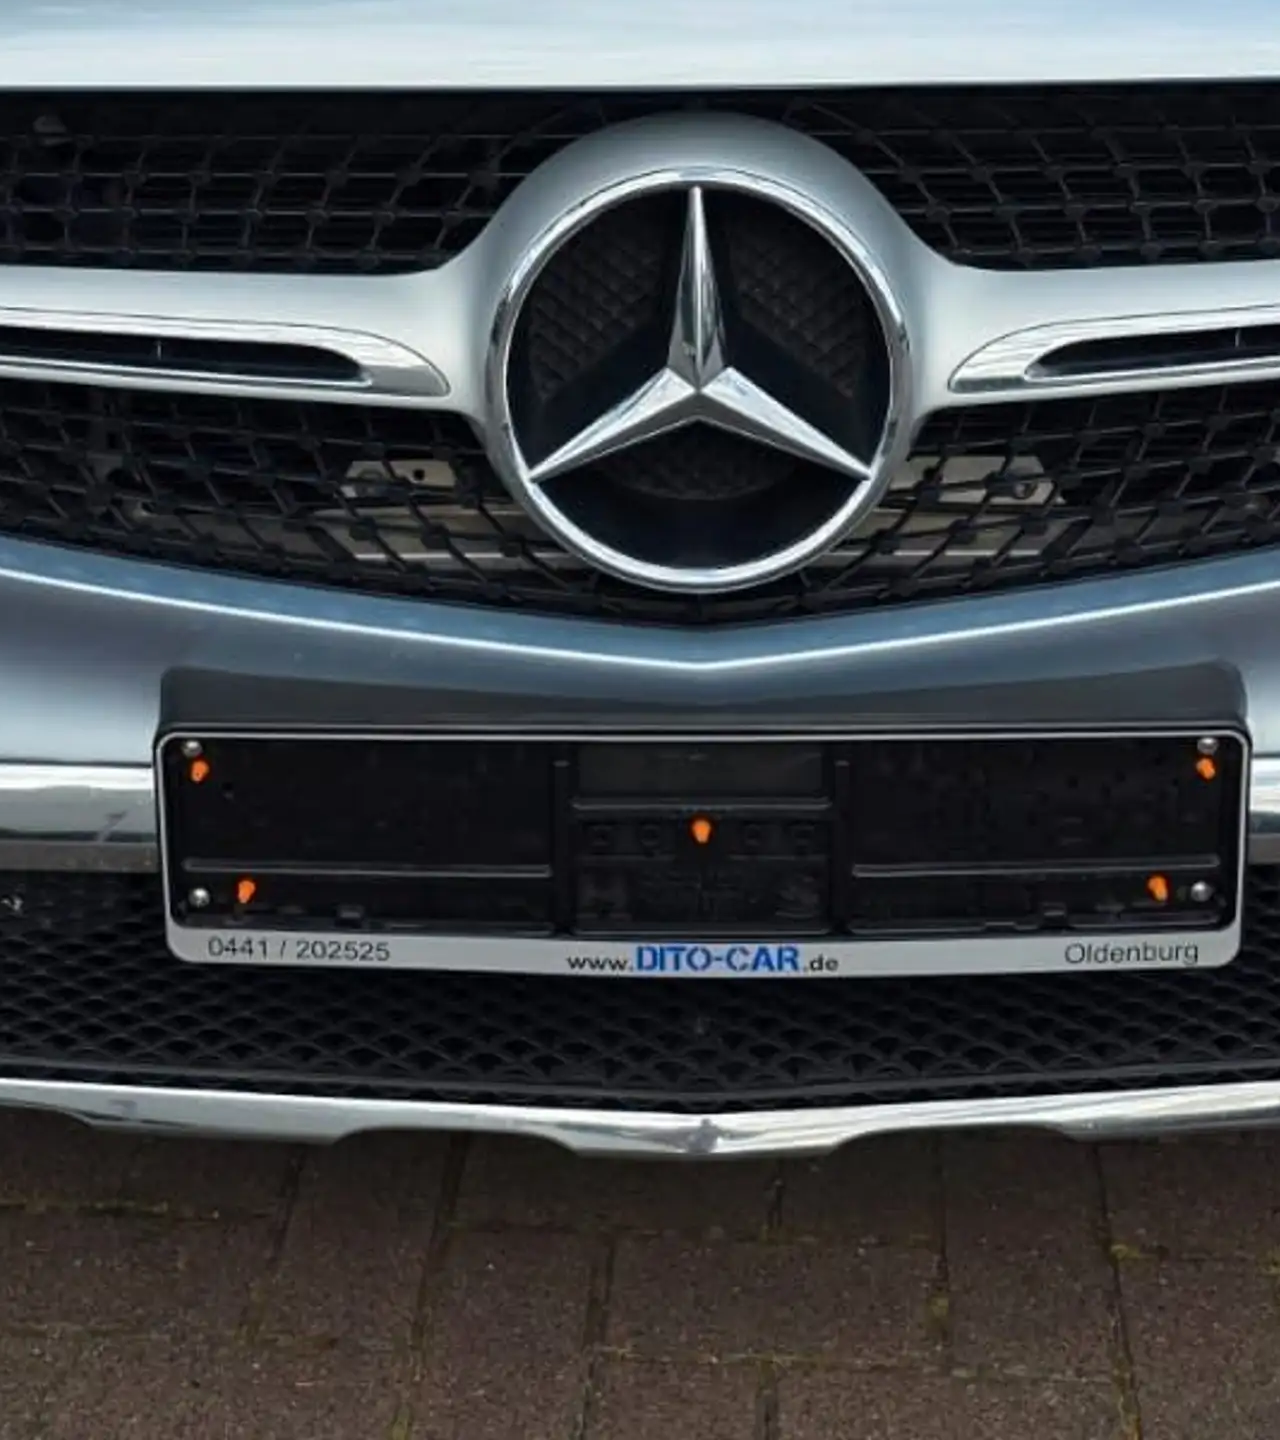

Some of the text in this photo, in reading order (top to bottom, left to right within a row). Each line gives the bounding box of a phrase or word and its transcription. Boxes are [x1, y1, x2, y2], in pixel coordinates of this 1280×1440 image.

[208, 936, 391, 962] 0441 / 202525
[567, 945, 840, 972] www.DITO-CAR.de
[1064, 941, 1199, 966] Oldenburg
